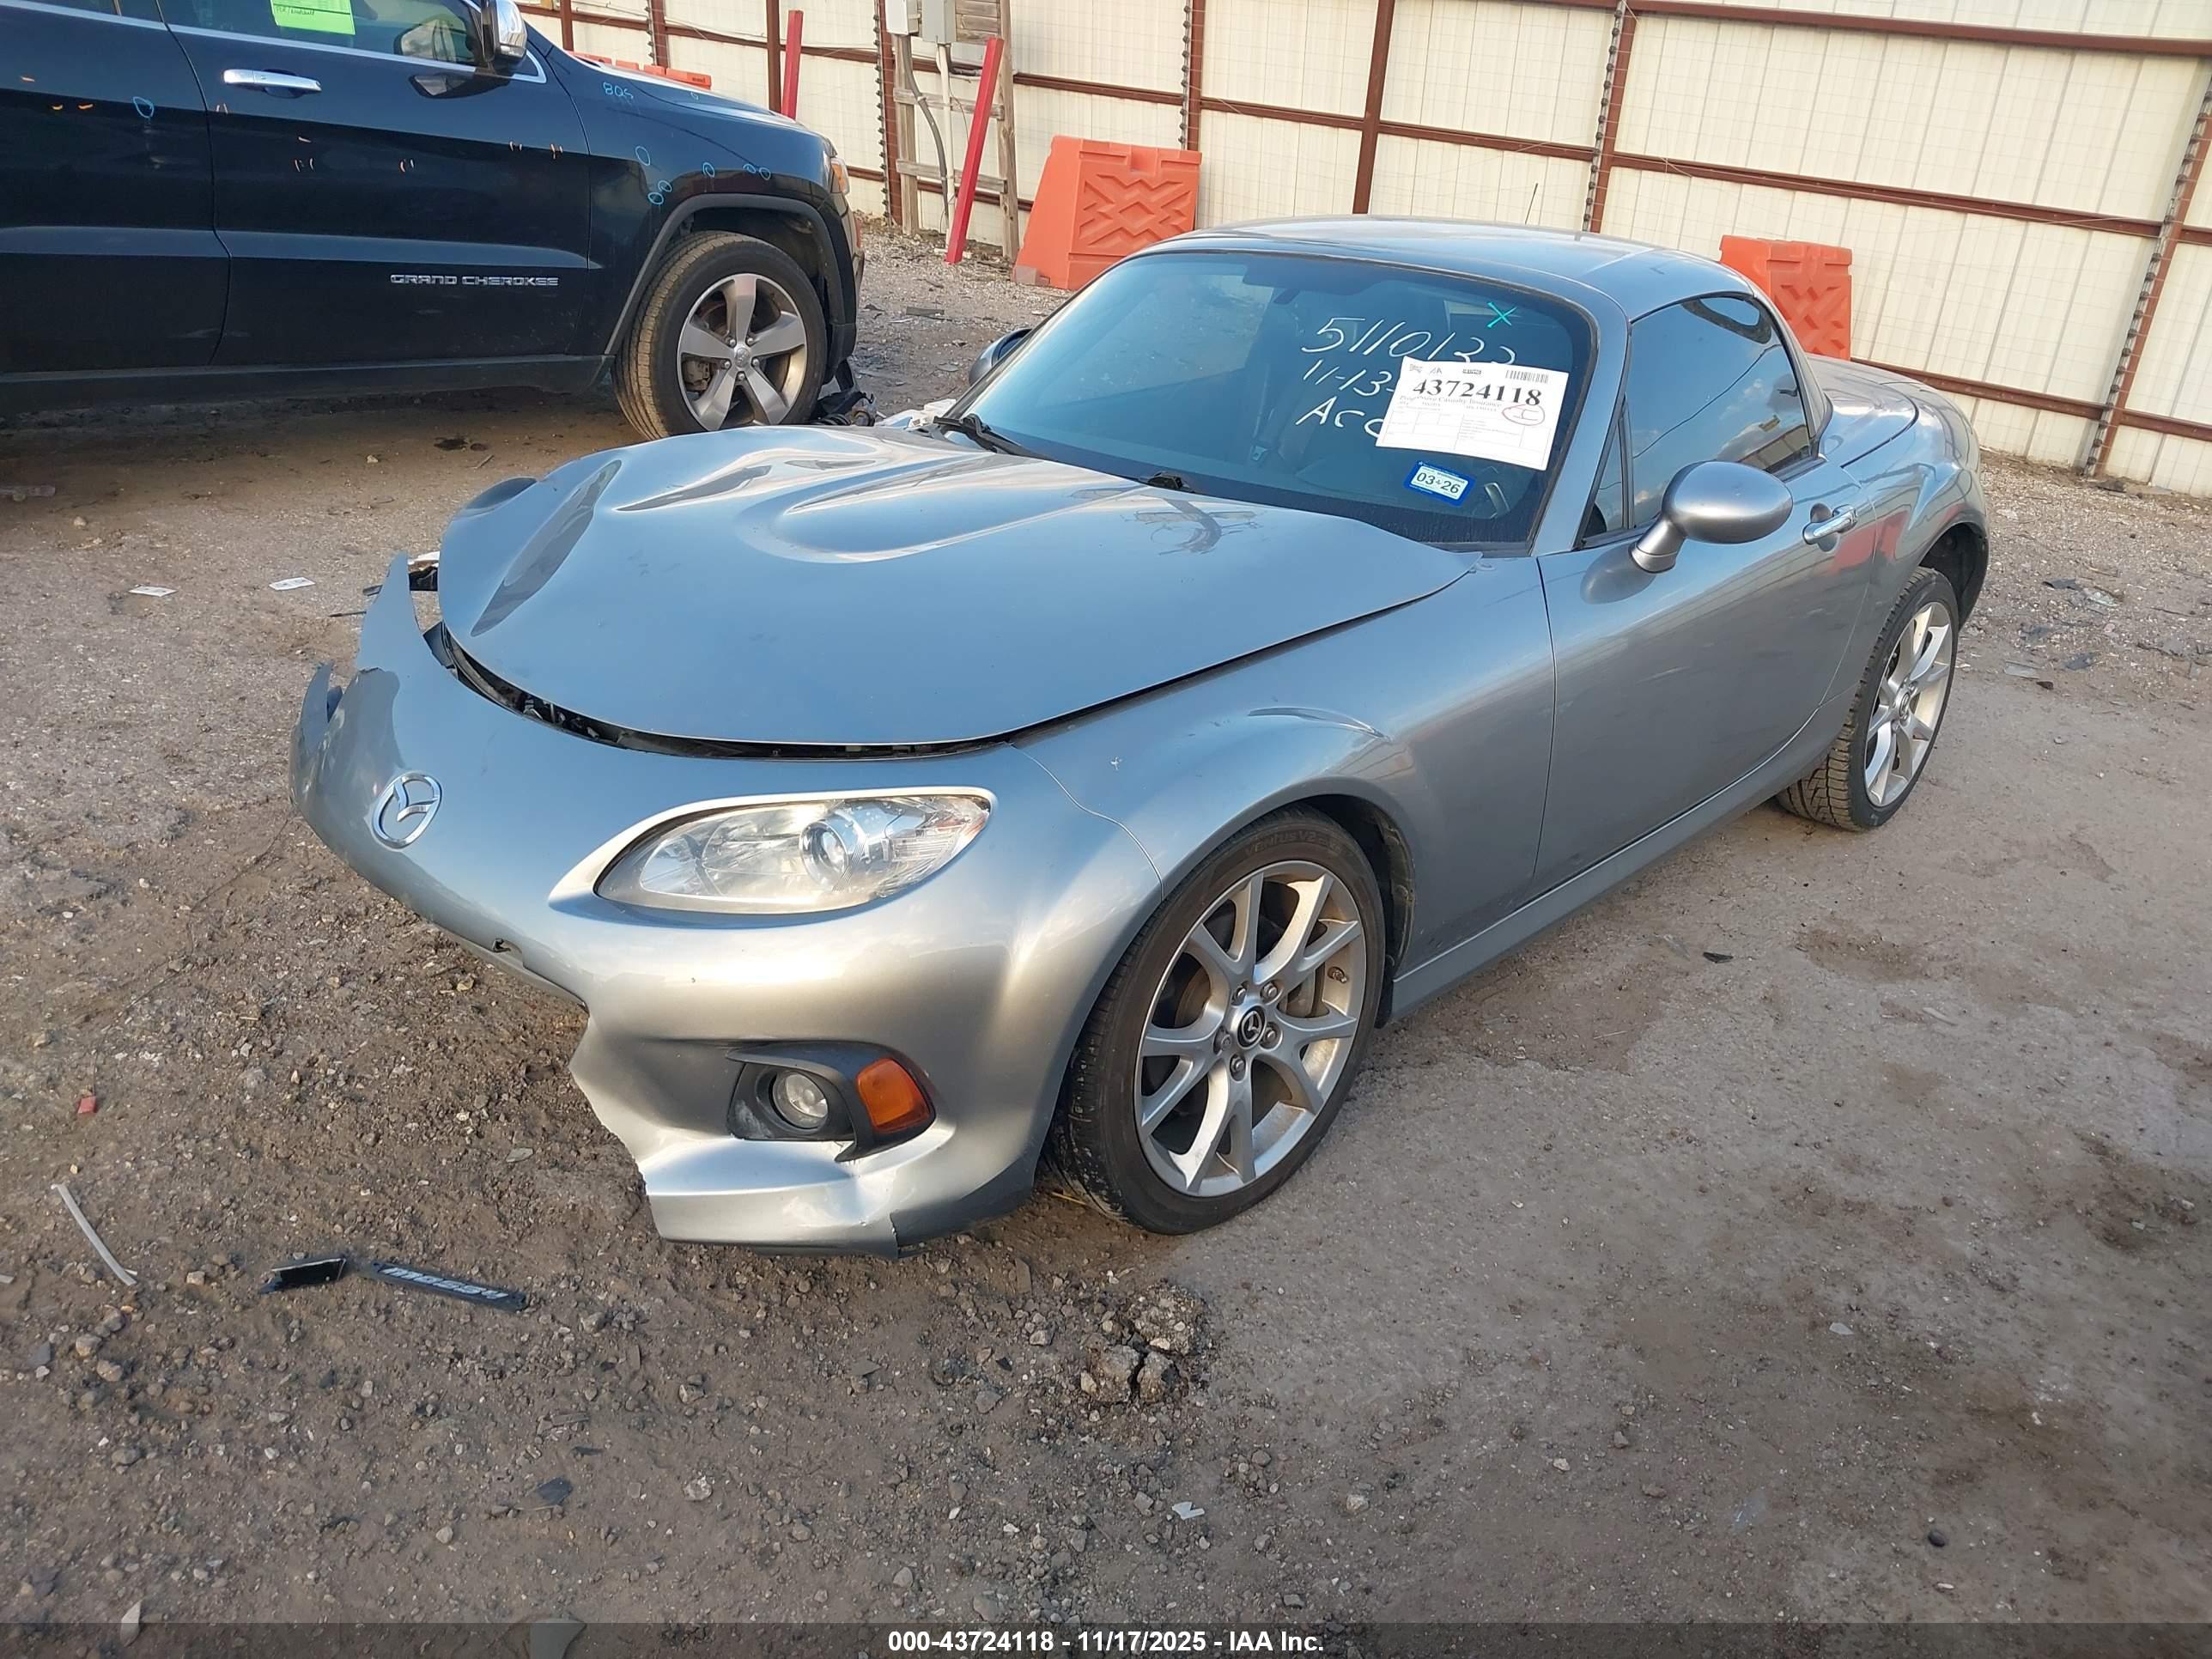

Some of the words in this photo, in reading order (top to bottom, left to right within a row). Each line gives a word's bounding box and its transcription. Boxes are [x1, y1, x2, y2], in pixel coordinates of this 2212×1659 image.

[391, 274, 457, 285] GRAND
[462, 276, 559, 286] CHEROKEE
[1412, 379, 1542, 406] 43724118
[1416, 472, 1436, 485] 03
[1440, 481, 1462, 494] 26
